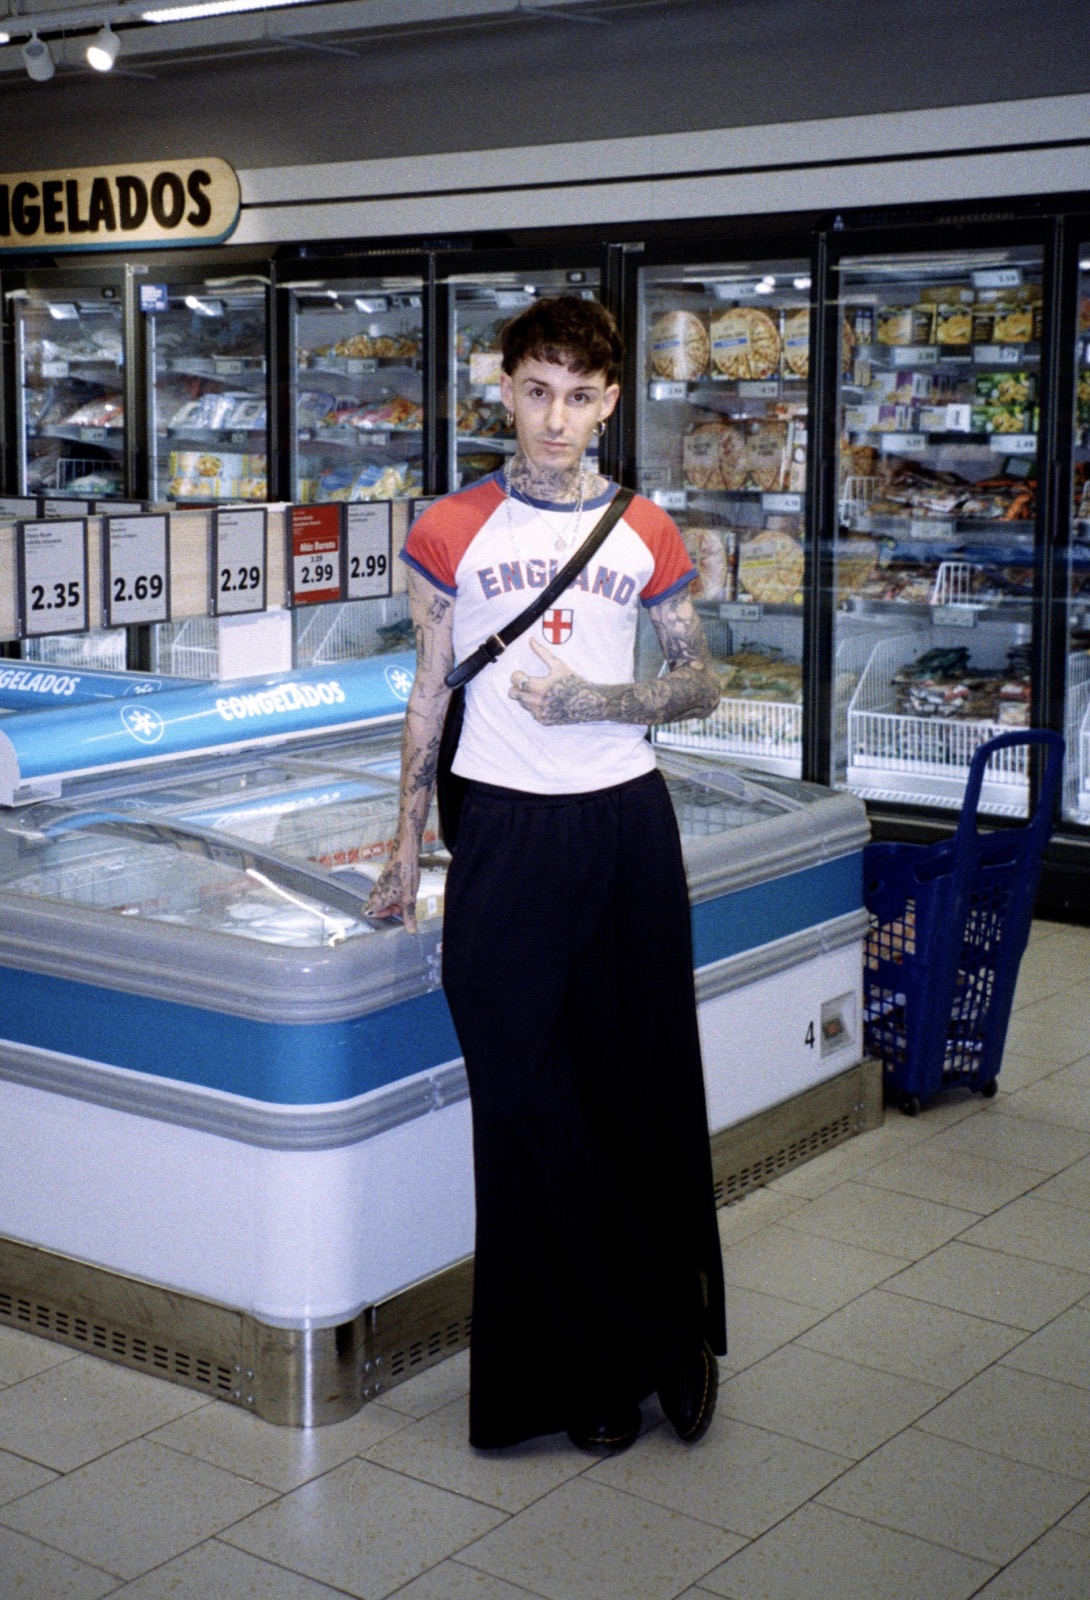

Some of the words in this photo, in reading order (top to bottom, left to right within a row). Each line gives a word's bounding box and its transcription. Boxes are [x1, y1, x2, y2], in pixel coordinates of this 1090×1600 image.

[221, 566, 261, 592] 2.29
[301, 563, 334, 584] 2.99
[351, 554, 387, 578] 2.99
[31, 582, 80, 610] 2.35
[114, 574, 163, 602] 2.69
[0, 668, 81, 696] GELADOS
[216, 681, 346, 720] CONGELADOS
[805, 1021, 815, 1049] 4
